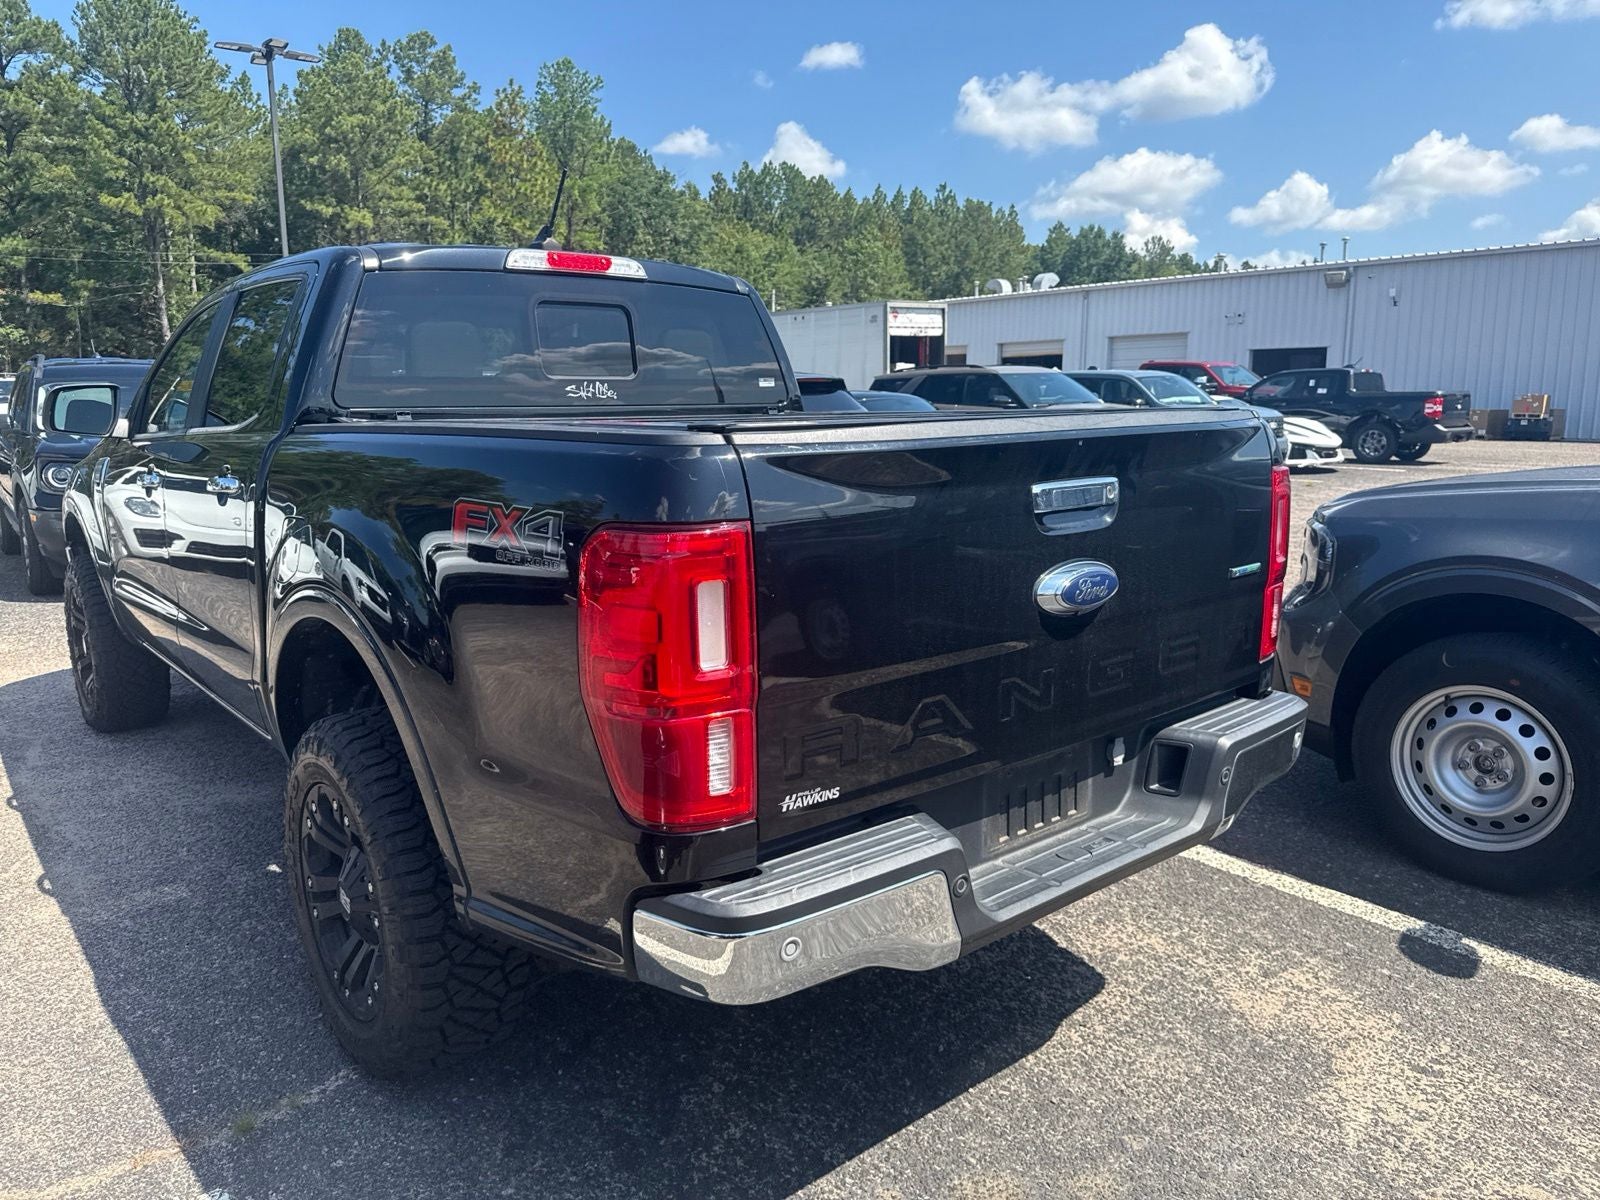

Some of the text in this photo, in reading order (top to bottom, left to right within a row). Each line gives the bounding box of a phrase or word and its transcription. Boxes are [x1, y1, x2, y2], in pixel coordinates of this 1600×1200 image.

[452, 497, 565, 560] FX4
[495, 549, 561, 572] OFF ROAD
[1075, 567, 1109, 602] Ford
[778, 787, 840, 812] HAWKINS
